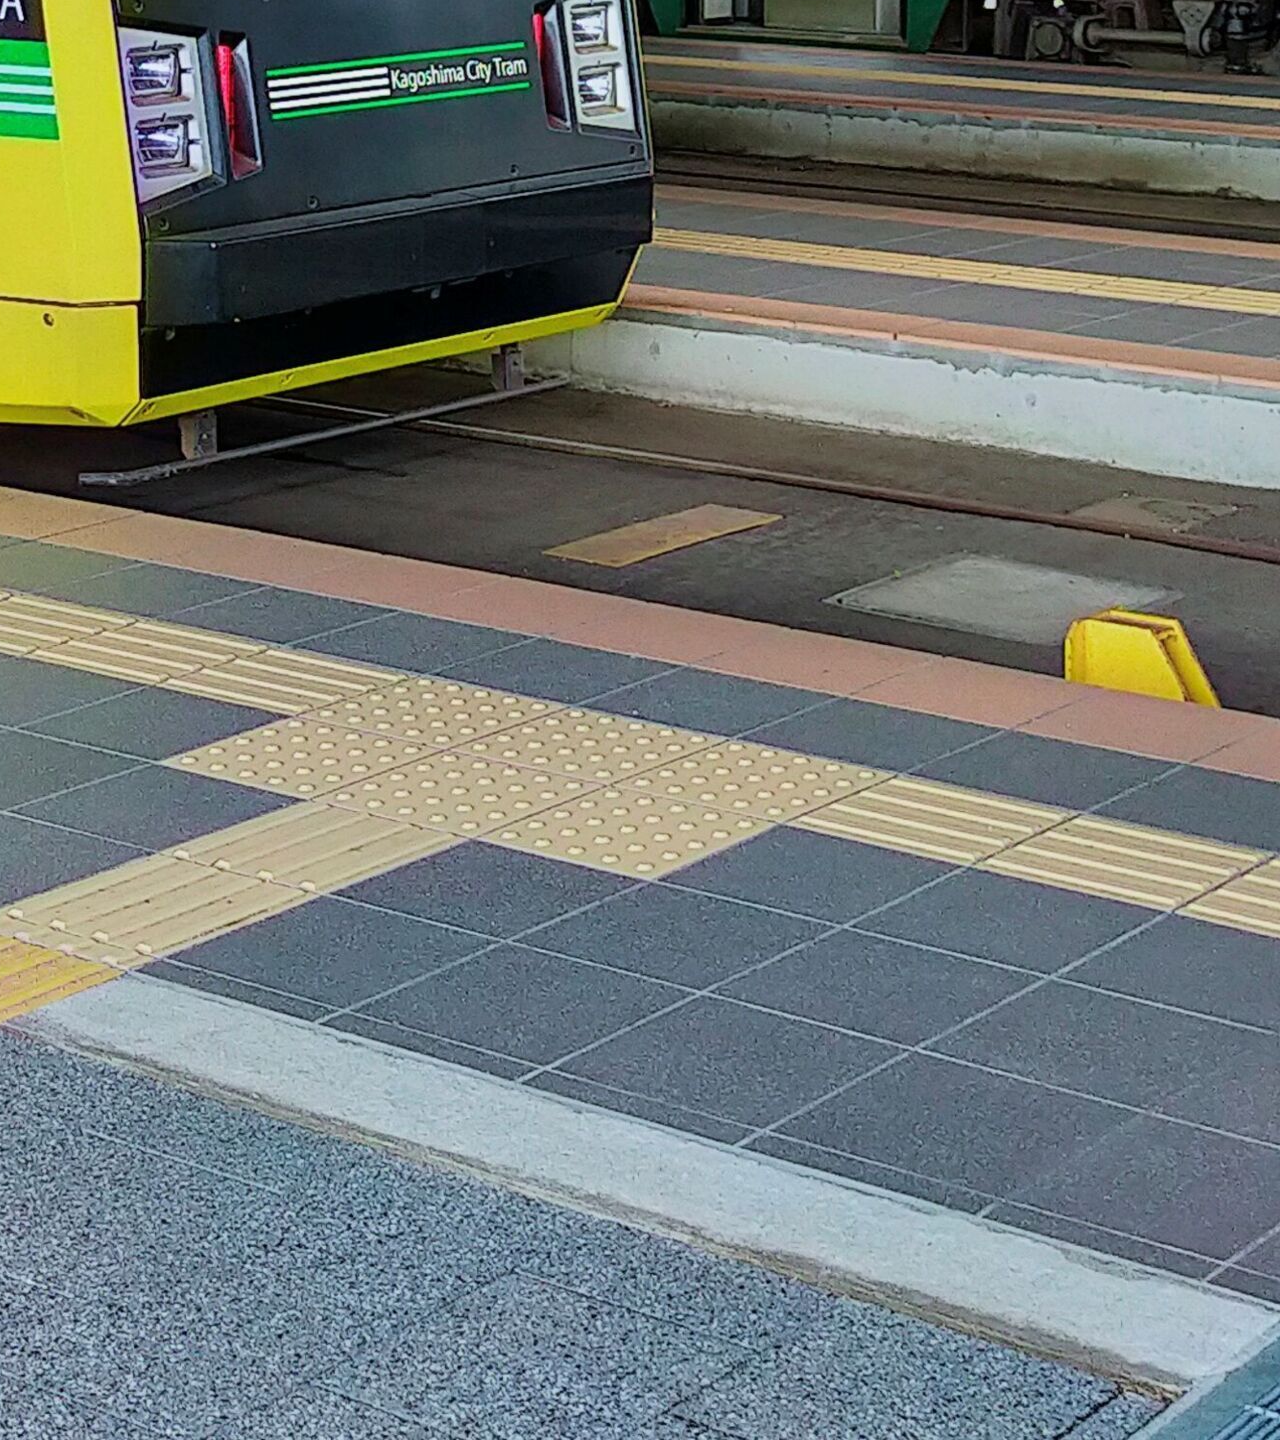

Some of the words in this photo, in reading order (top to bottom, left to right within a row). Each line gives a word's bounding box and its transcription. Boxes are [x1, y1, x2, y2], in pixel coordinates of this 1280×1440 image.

[389, 63, 465, 93] Kagoshima
[466, 60, 494, 84] City
[492, 57, 528, 80] Tram
